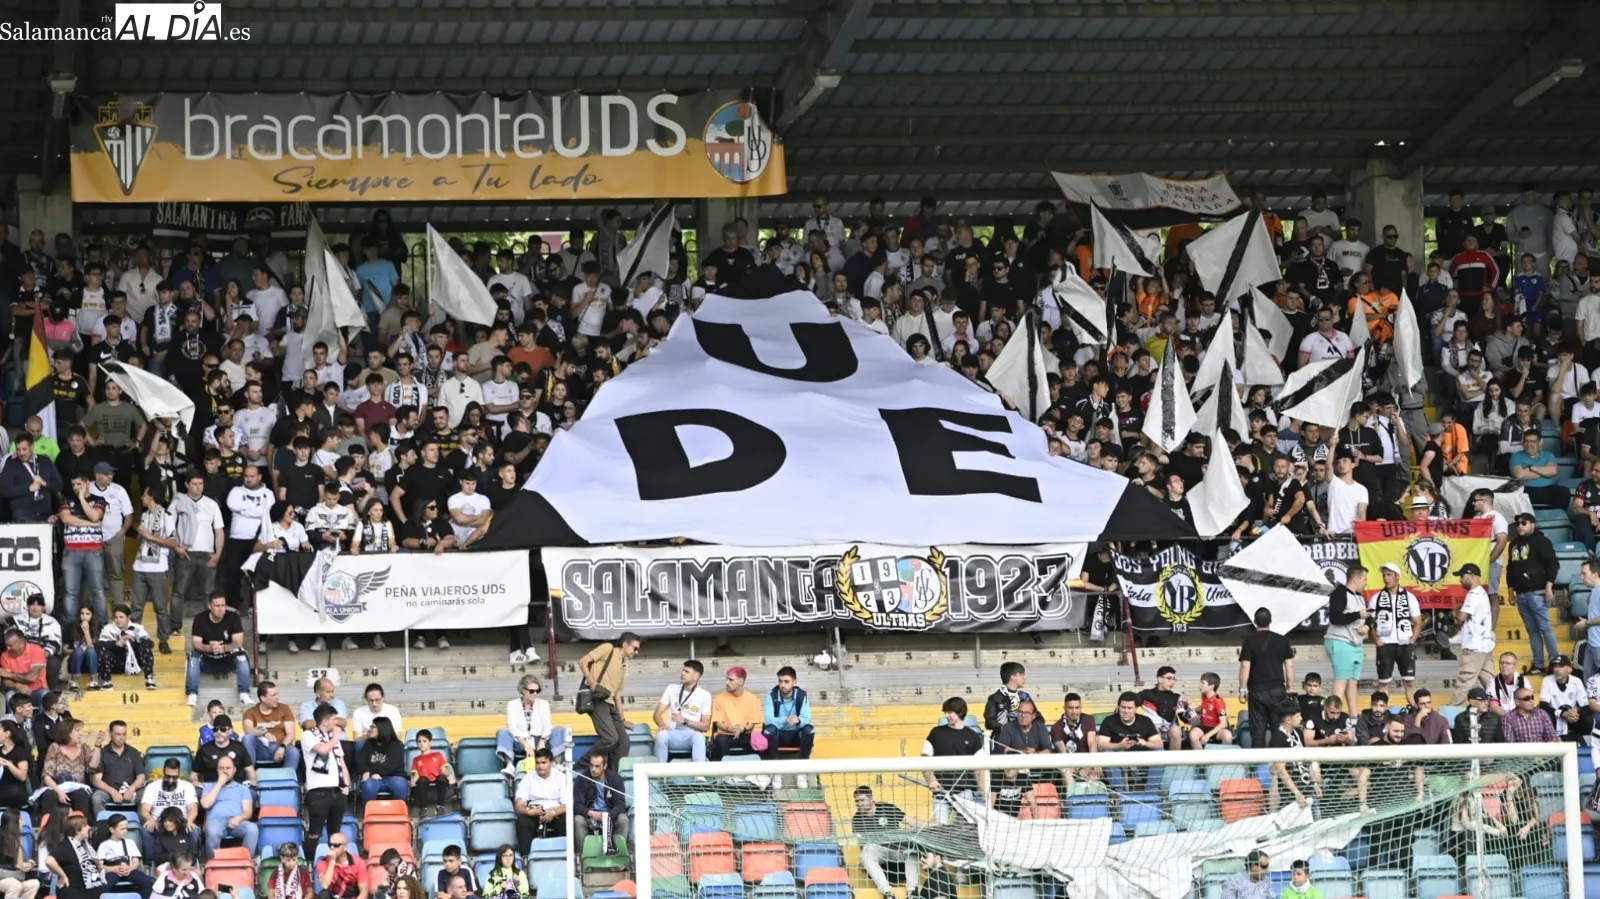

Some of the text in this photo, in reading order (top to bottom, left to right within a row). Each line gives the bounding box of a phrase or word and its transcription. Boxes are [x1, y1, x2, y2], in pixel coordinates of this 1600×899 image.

[185, 94, 687, 160] bracamonteUDS
[273, 163, 602, 195] Siempre a Tu lado
[156, 199, 237, 230] SALMANTICA
[692, 318, 858, 383] U
[614, 407, 1042, 503] D E
[1381, 520, 1470, 537] UDS FANS
[385, 584, 506, 598] PEÑA VIAJEROS UDS
[562, 556, 851, 629] SALAMANCA
[420, 598, 465, 607] caminarás
[468, 597, 485, 605] sola
[872, 612, 926, 629] ULTRAS
[1507, 630, 1521, 640] 11
[311, 670, 327, 678] 22
[363, 668, 378, 676] 20
[121, 692, 139, 704] 10
[132, 728, 141, 737] 9
